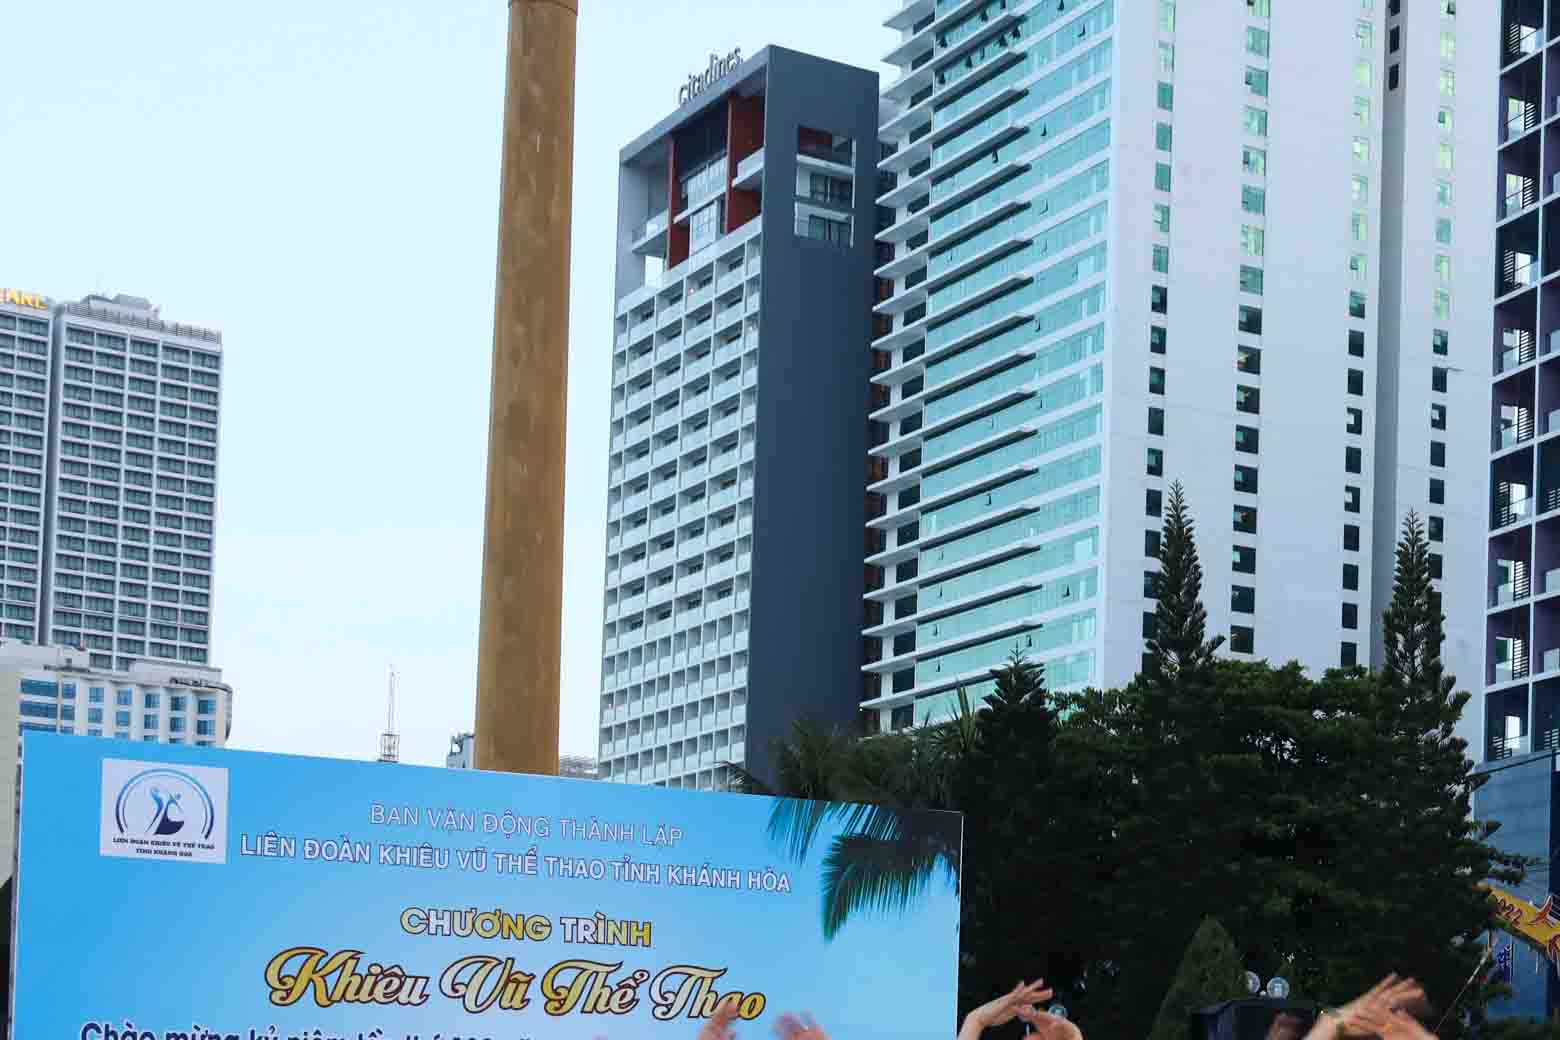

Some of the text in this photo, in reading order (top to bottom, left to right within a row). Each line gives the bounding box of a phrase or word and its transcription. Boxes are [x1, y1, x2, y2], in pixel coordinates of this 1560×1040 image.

[370, 803, 420, 826] BAN
[483, 808, 552, 840] ĐỘNG
[559, 815, 635, 842] THÀNH
[240, 831, 792, 893] LIÊN ĐOÀN KHIÊU VŨ THỂ THAO TỈNH KHÁNH HÒA
[399, 906, 653, 947] CHƯƠNG TRÌNH
[263, 946, 431, 1009] Khiêu
[439, 955, 536, 1016] Vũ
[542, 959, 651, 1017] Thể
